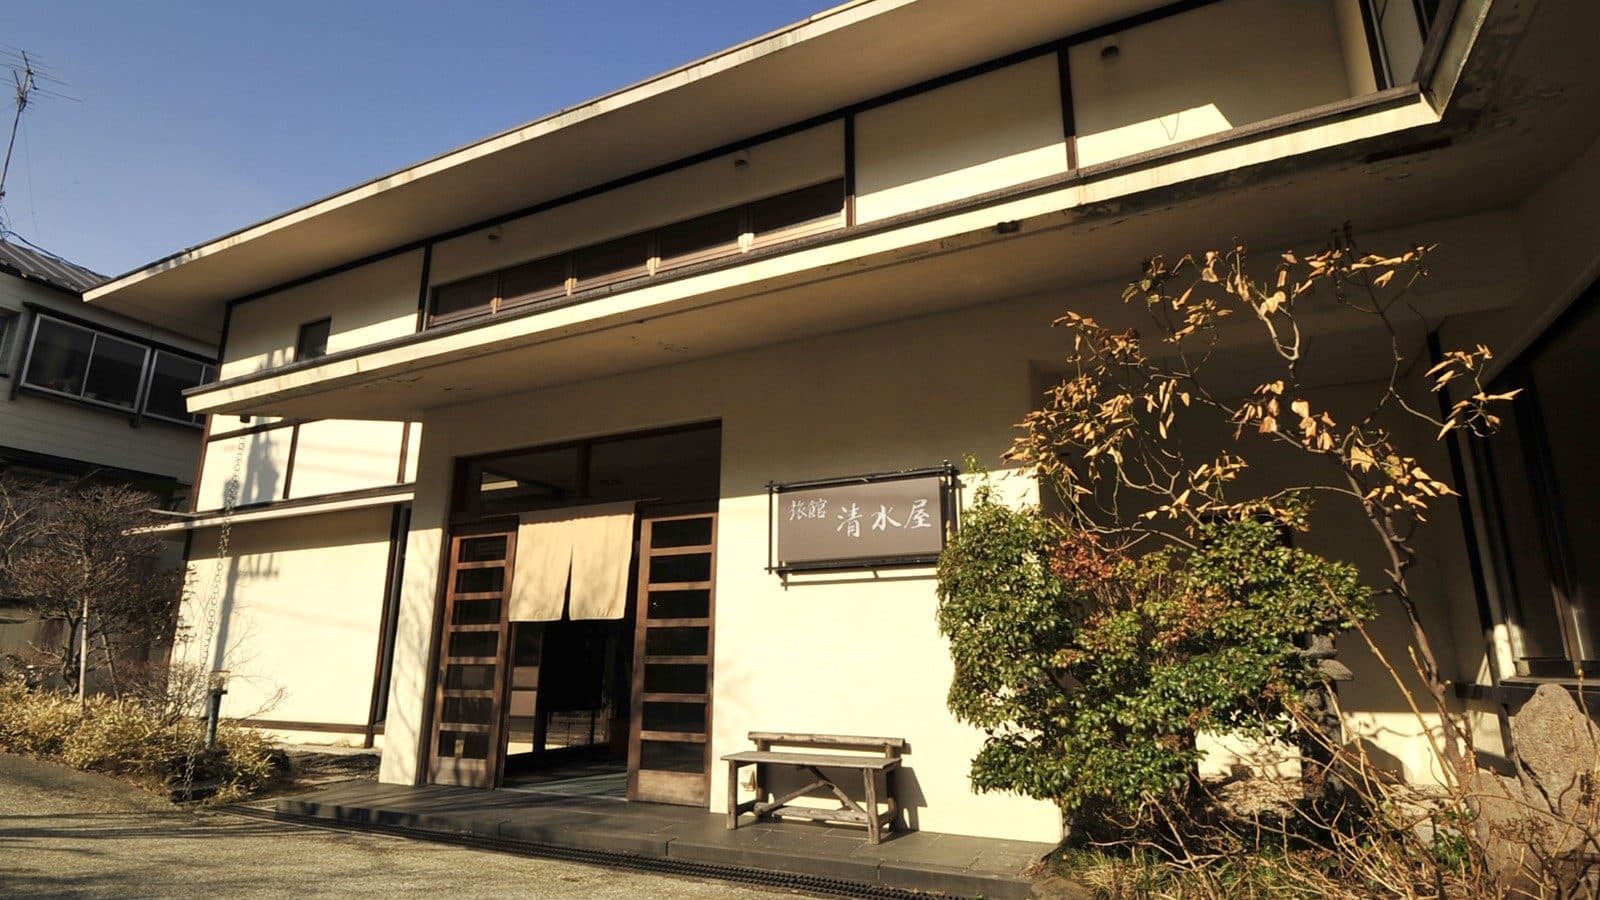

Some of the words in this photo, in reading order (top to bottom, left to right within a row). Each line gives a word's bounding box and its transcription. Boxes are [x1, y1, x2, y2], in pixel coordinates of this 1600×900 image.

[789, 498, 828, 521] 旅館
[836, 498, 933, 538] 清水屋
